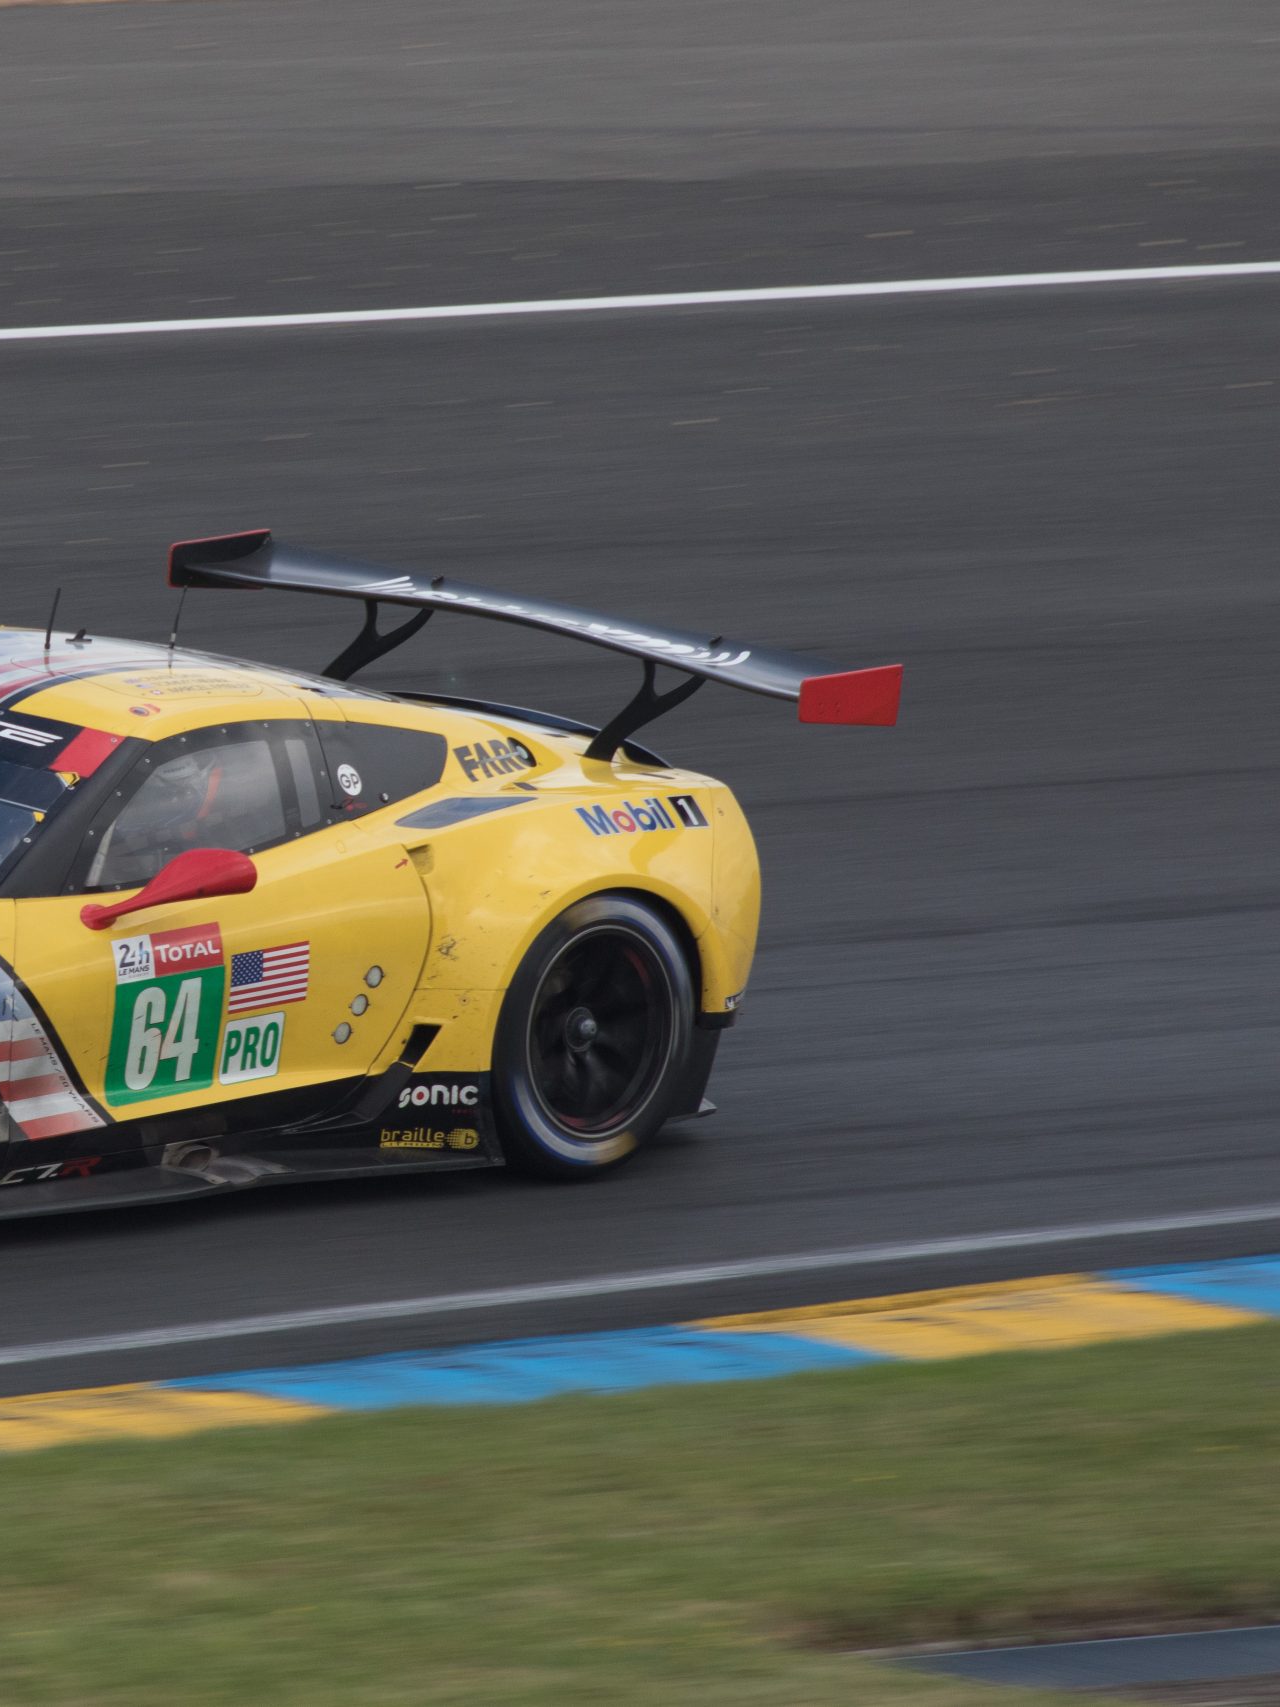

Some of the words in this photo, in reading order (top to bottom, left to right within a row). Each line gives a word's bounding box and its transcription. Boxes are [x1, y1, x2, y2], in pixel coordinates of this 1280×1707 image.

[338, 771, 359, 788] GP
[574, 798, 675, 836] Mobil
[154, 940, 220, 963] TOTAL
[128, 964, 150, 975] MANS
[124, 976, 202, 1091] 64
[221, 1021, 280, 1075] PRO
[380, 1127, 445, 1143] braille
